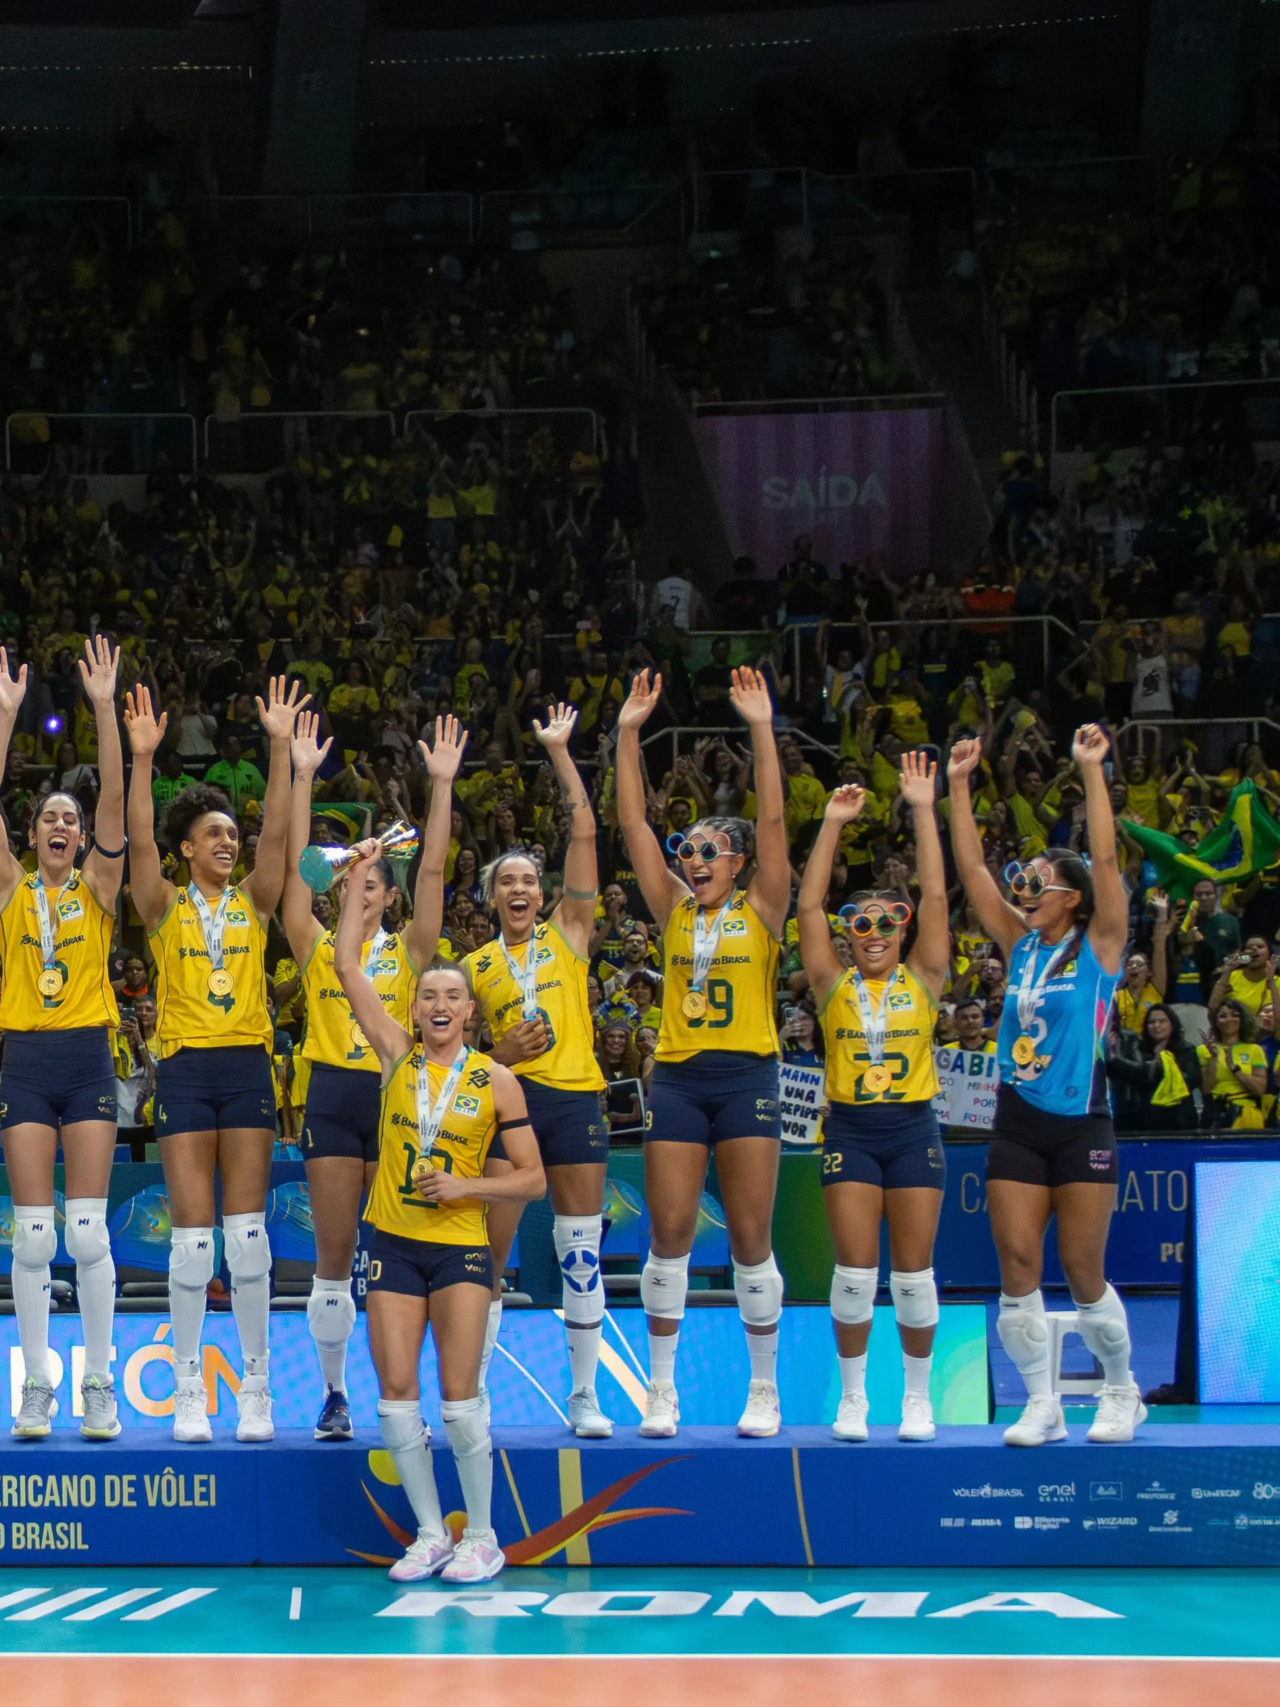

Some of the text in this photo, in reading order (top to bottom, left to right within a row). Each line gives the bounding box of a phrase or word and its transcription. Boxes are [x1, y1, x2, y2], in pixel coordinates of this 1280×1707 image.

[762, 464, 889, 509] SAÍDA
[62, 935, 86, 948] BRASIL
[721, 956, 751, 965] BRASIL
[329, 989, 346, 998] BAN
[893, 1029, 920, 1038] BRASIL
[936, 1049, 995, 1078] GABI
[853, 1052, 910, 1101] 22
[784, 1085, 816, 1104] UNA
[159, 1104, 168, 1123] 4
[441, 1130, 469, 1146] BRASIL
[823, 1153, 843, 1174] 22
[103, 1475, 136, 1508] DE
[143, 1467, 218, 1508] VÔLEI
[992, 1489, 1024, 1497] BRASIL
[1038, 1481, 1077, 1496] enel
[1096, 1517, 1138, 1526] WIZARD
[12, 1522, 89, 1550] BRASIL
[372, 1590, 1127, 1619] ROMA
